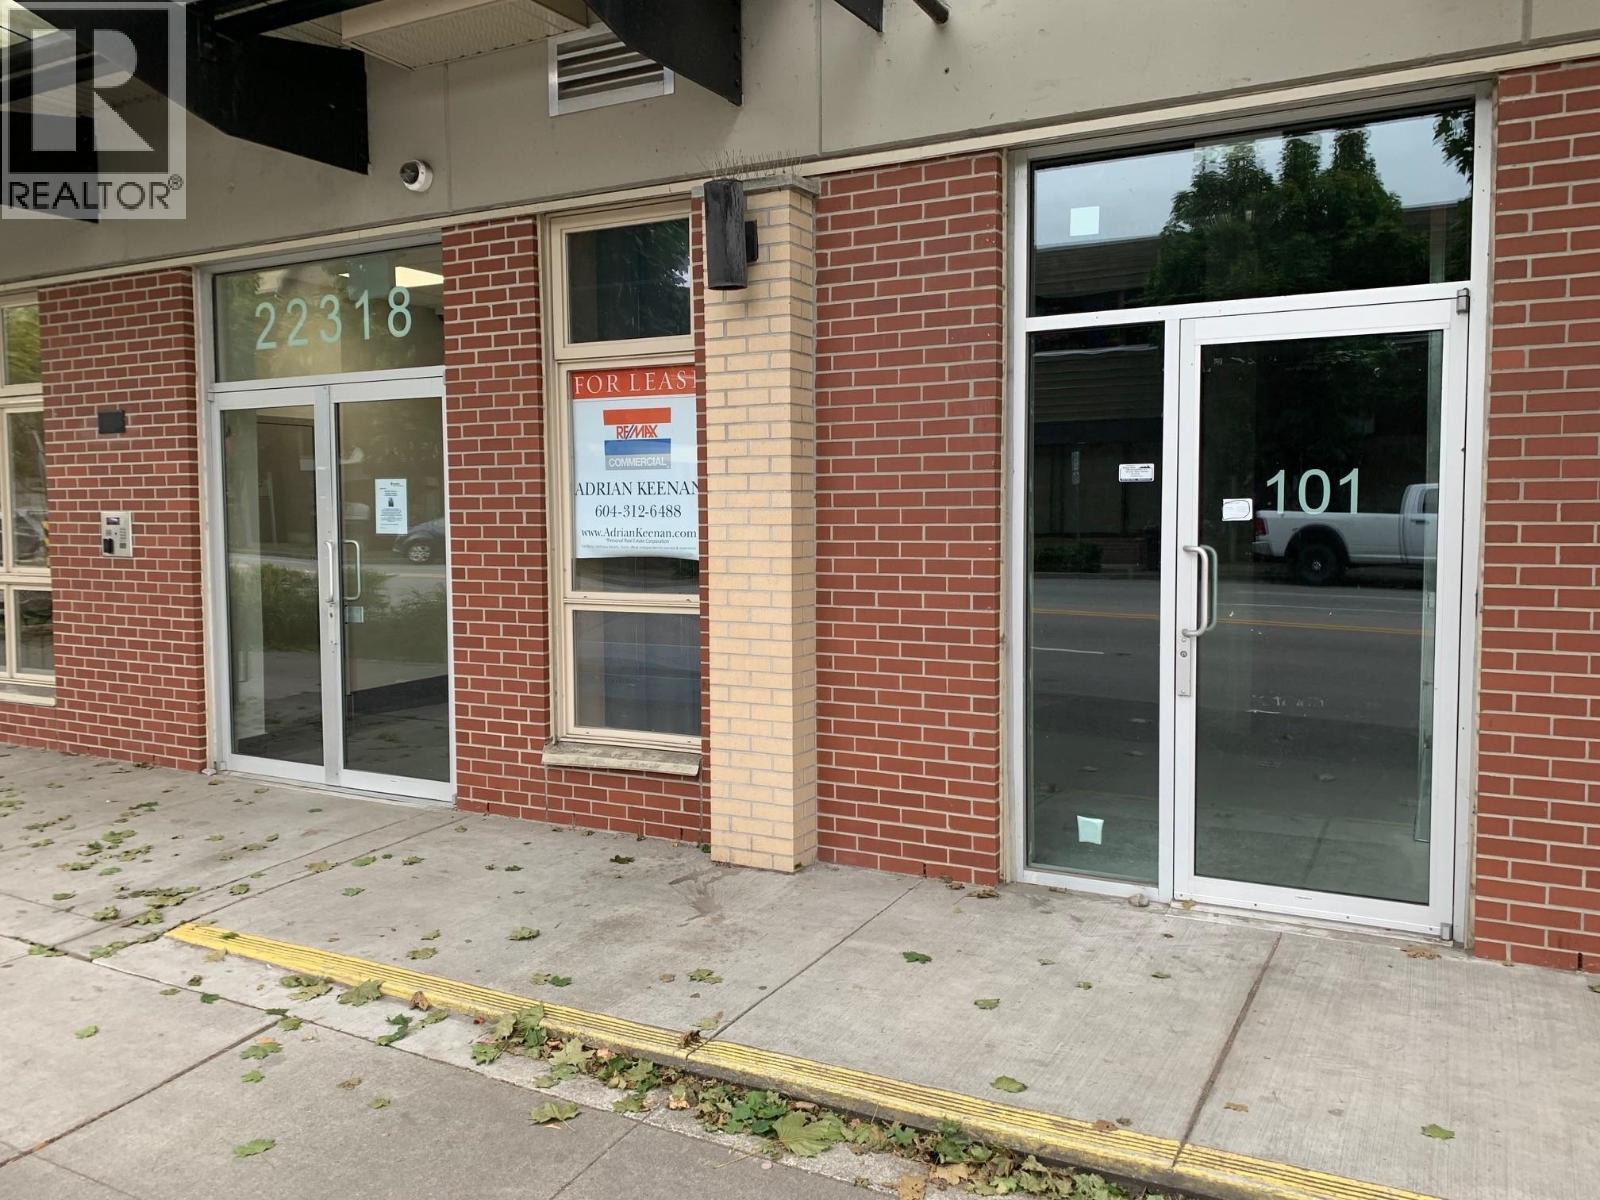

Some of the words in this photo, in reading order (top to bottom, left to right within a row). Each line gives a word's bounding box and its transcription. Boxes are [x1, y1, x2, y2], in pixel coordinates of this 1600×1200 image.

[255, 286, 412, 350] 22318
[574, 374, 621, 394] FOR
[616, 424, 658, 440] RE/MAX
[608, 455, 668, 468] COMMERCIAL
[575, 481, 632, 496] ADRIAN
[1266, 468, 1360, 515] 101
[595, 504, 682, 518] 604-312-6488
[581, 527, 697, 538] www.AdrianKeenan.com
